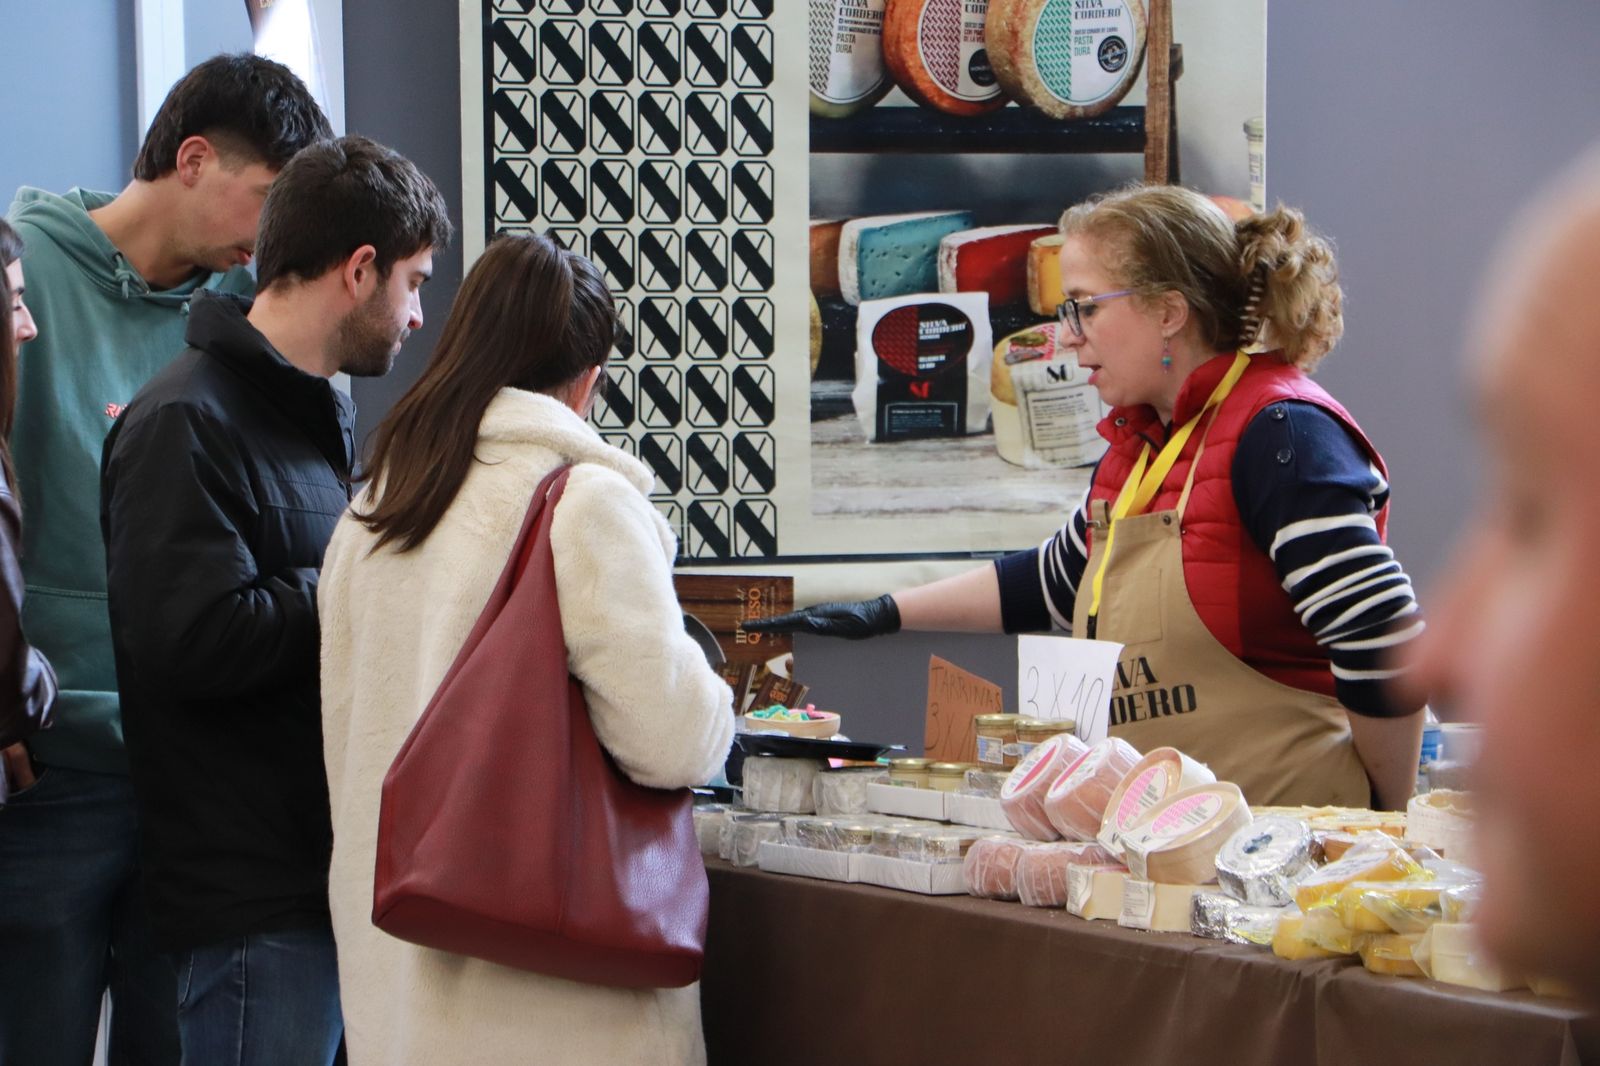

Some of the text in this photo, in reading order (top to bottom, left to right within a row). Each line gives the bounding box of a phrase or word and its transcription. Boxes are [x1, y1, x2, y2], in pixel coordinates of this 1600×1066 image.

[1074, 8, 1121, 20] CORDERO
[836, 33, 856, 44] PASTA
[1074, 35, 1093, 45] PASTA
[835, 43, 852, 54] DURA
[1074, 46, 1091, 56] DURA
[748, 587, 762, 645] QESO
[1112, 656, 1159, 692] VA
